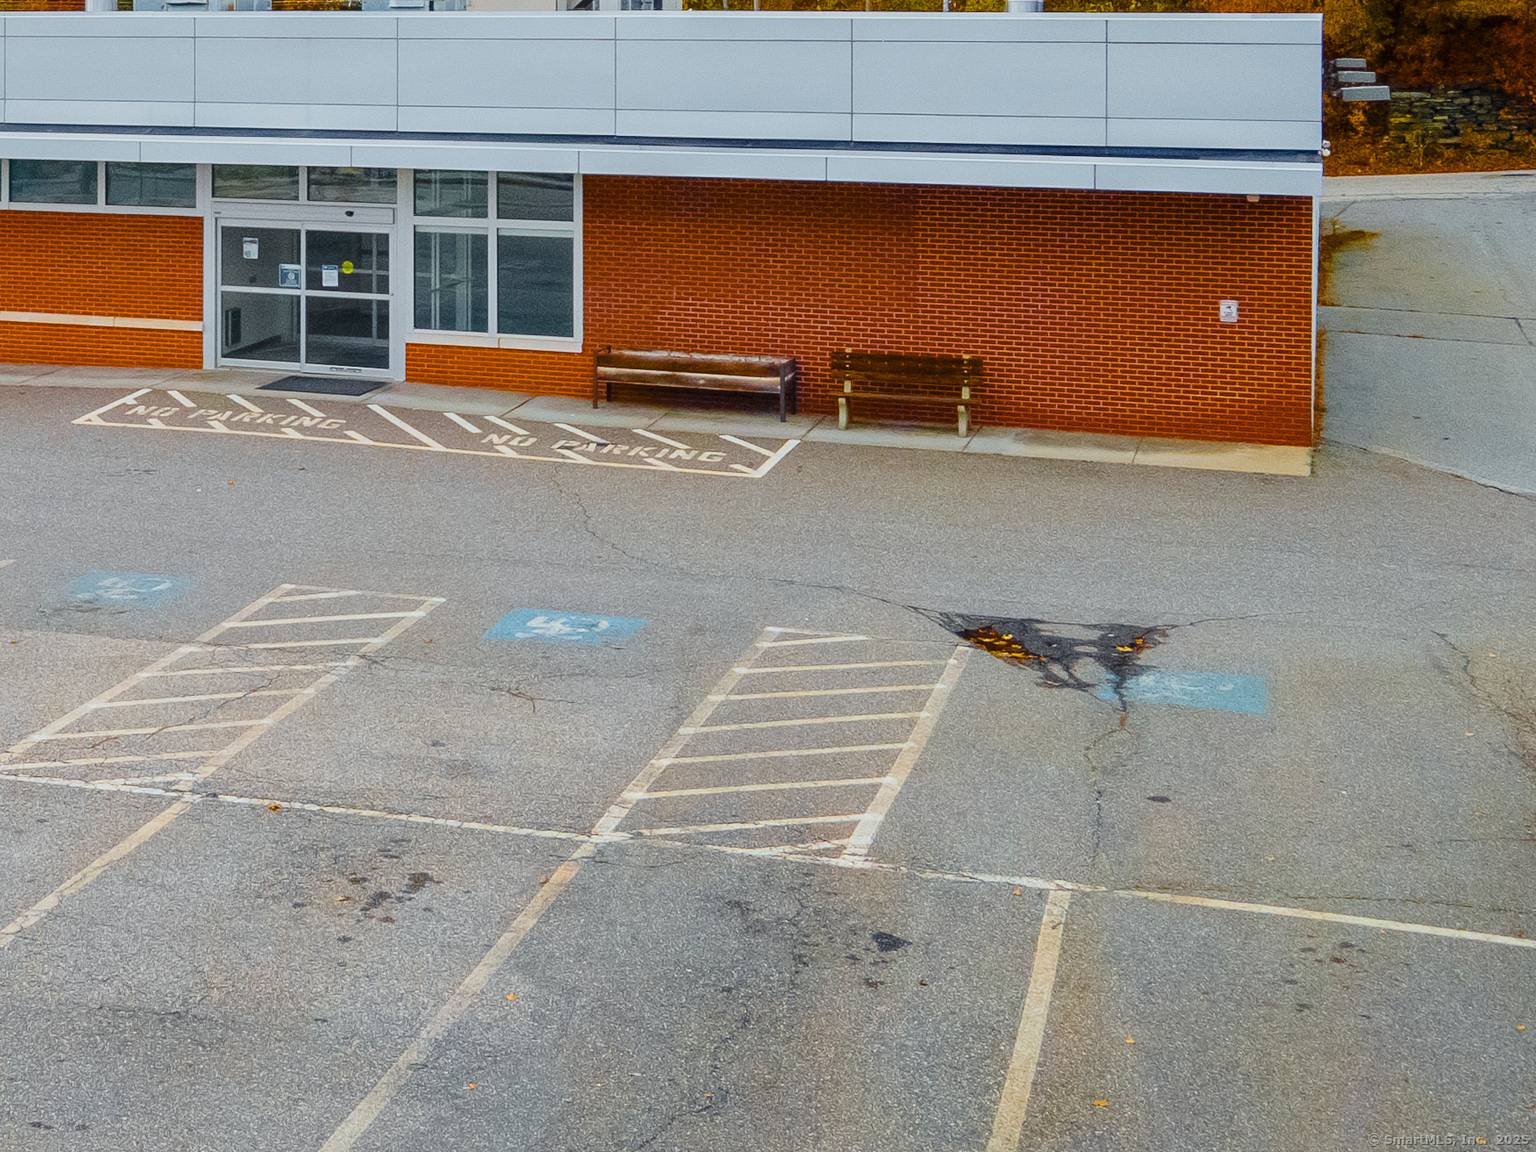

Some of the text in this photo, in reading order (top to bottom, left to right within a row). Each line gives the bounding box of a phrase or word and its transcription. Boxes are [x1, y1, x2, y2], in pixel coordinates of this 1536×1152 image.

[124, 405, 347, 430] NO PARKING
[481, 433, 727, 462] NO PARKING
